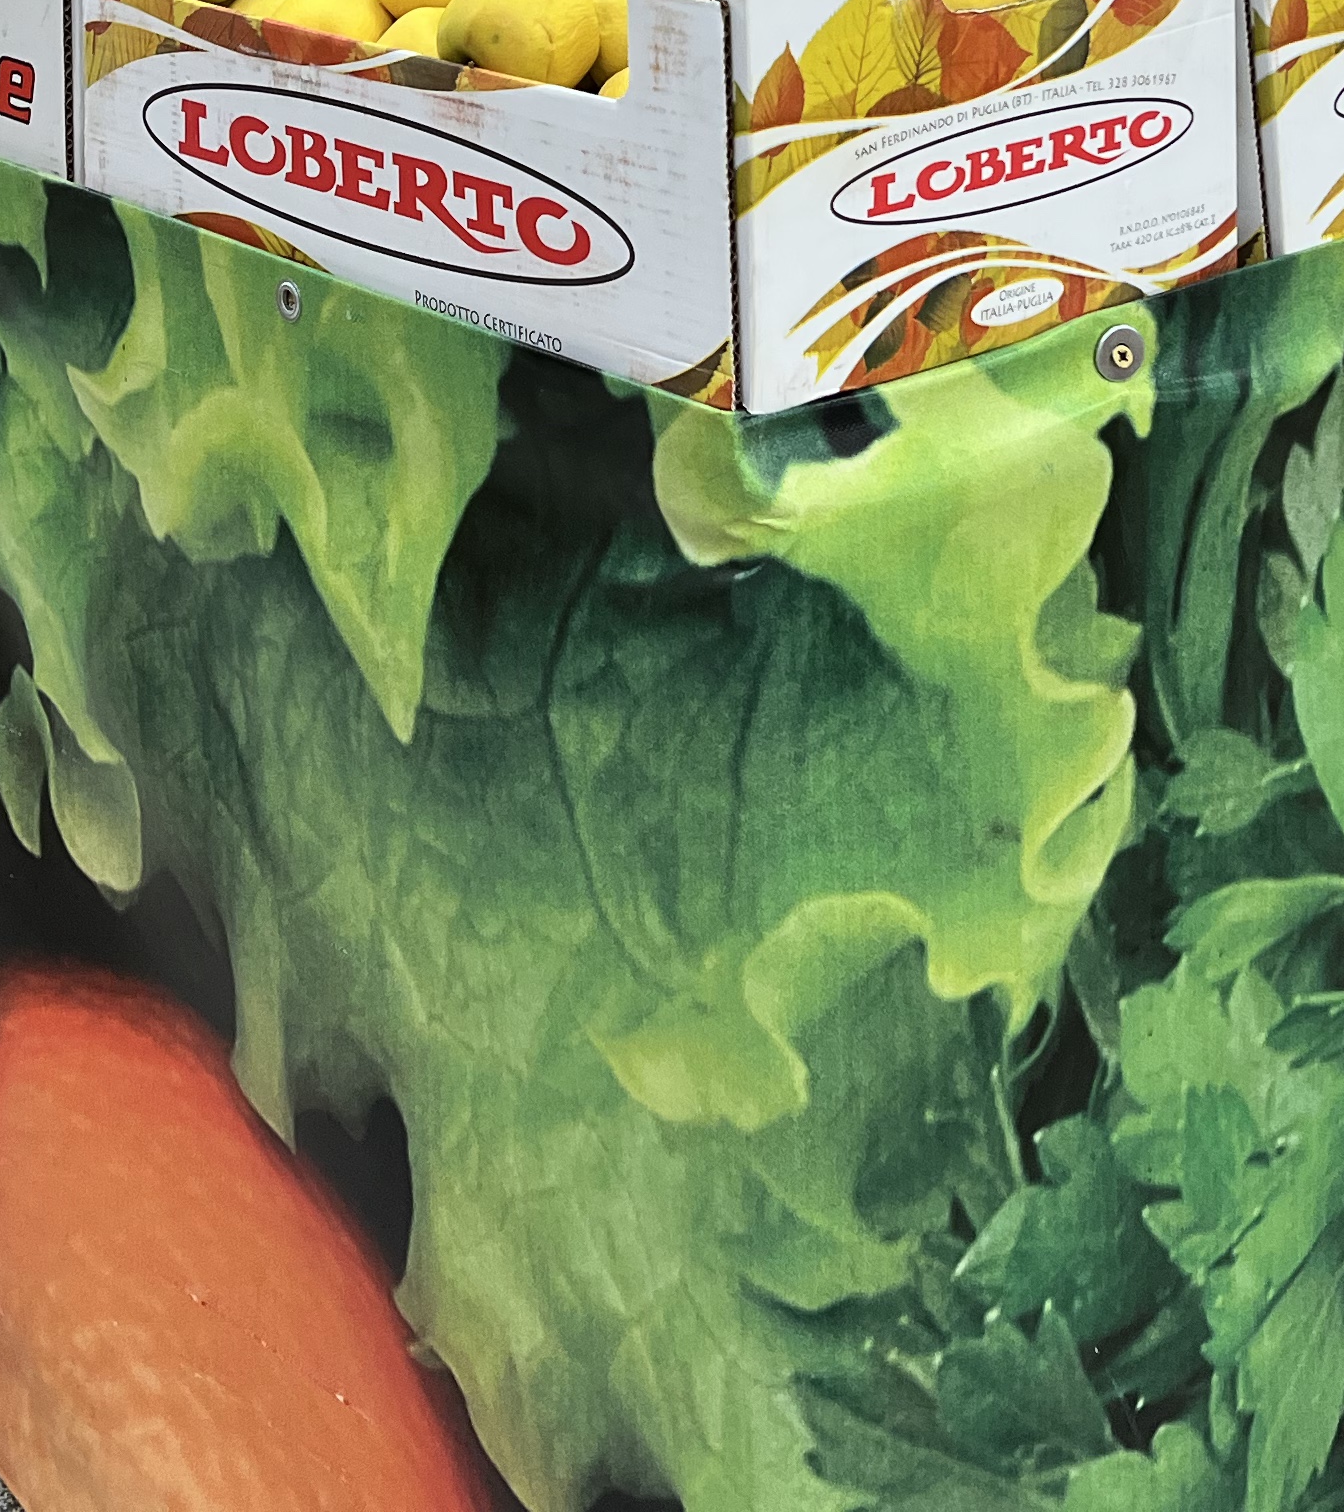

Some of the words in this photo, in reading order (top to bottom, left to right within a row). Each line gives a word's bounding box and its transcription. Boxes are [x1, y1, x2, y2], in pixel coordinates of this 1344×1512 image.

[854, 140, 879, 161] SAN
[881, 114, 954, 150] FERDINANDO
[957, 108, 969, 124] DI
[972, 100, 1009, 120] PUGLIA
[1011, 93, 1033, 110] (BT)
[1042, 84, 1077, 103] ITALIA
[1108, 75, 1128, 90] 328
[1131, 72, 1177, 88] 3061967
[178, 98, 592, 266] LOBERTO
[866, 110, 1173, 219] LOBERTO
[415, 289, 480, 325] PRODOTTO
[484, 313, 563, 353] CERTIFICATO
[981, 291, 1053, 322] ITALIA-PUGLIA
[999, 282, 1036, 302] ORIGINE
